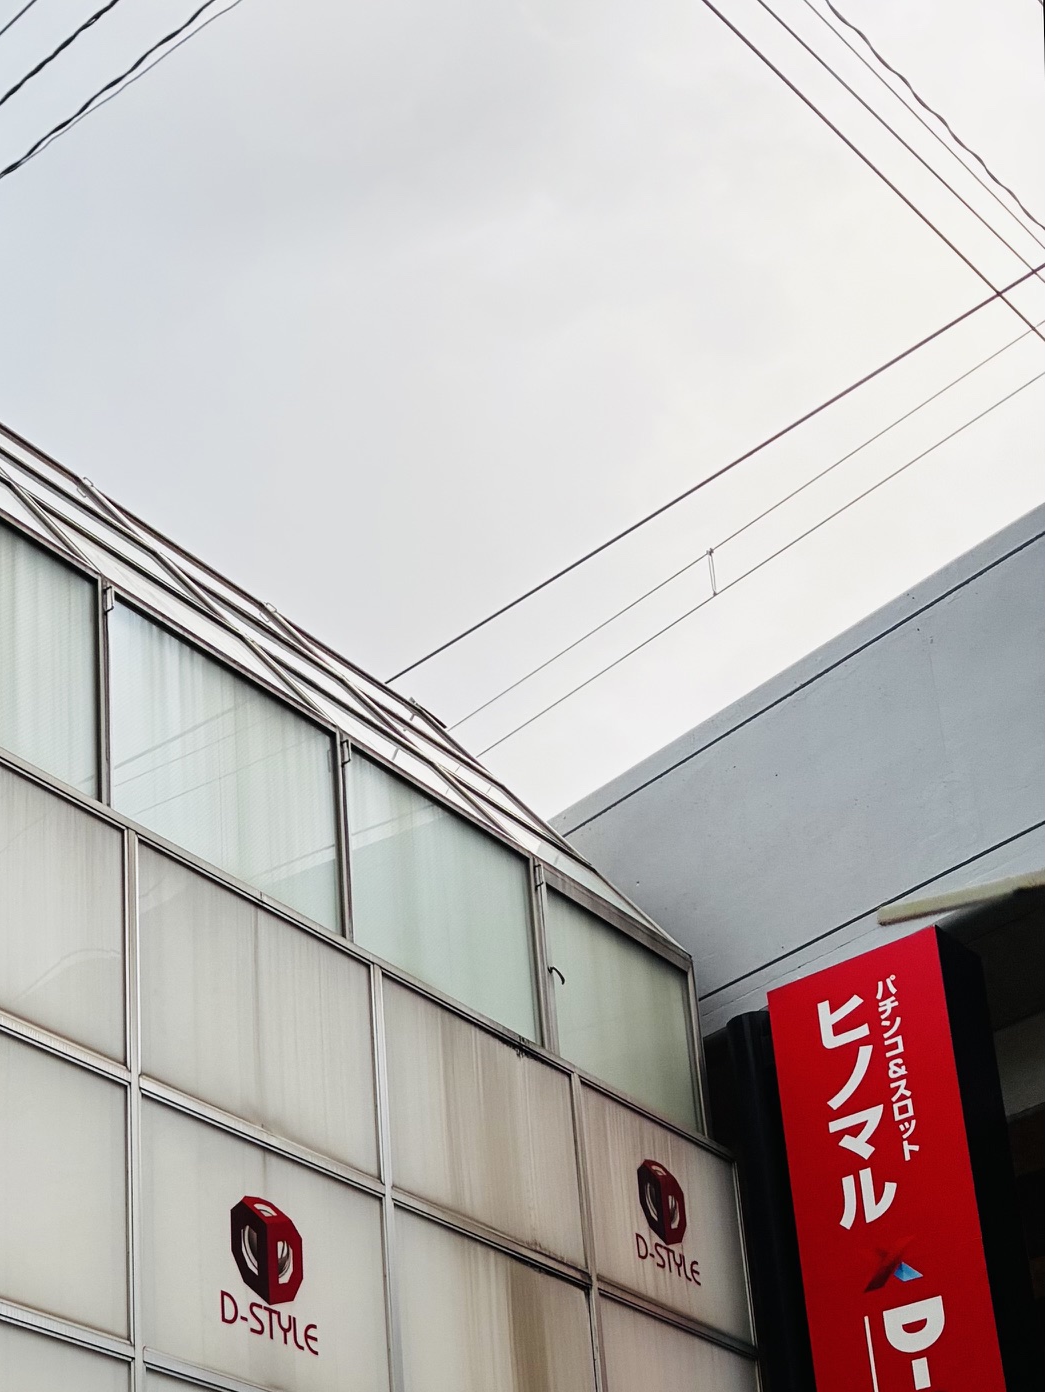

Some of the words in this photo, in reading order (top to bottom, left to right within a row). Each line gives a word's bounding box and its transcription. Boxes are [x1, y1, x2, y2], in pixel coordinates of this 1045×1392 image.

[817, 994, 898, 1230] ヒノマル
[876, 974, 920, 1161] パチンコ&スロット
[635, 1232, 701, 1286] D-STYLE
[221, 1290, 319, 1356] D-STYLE
